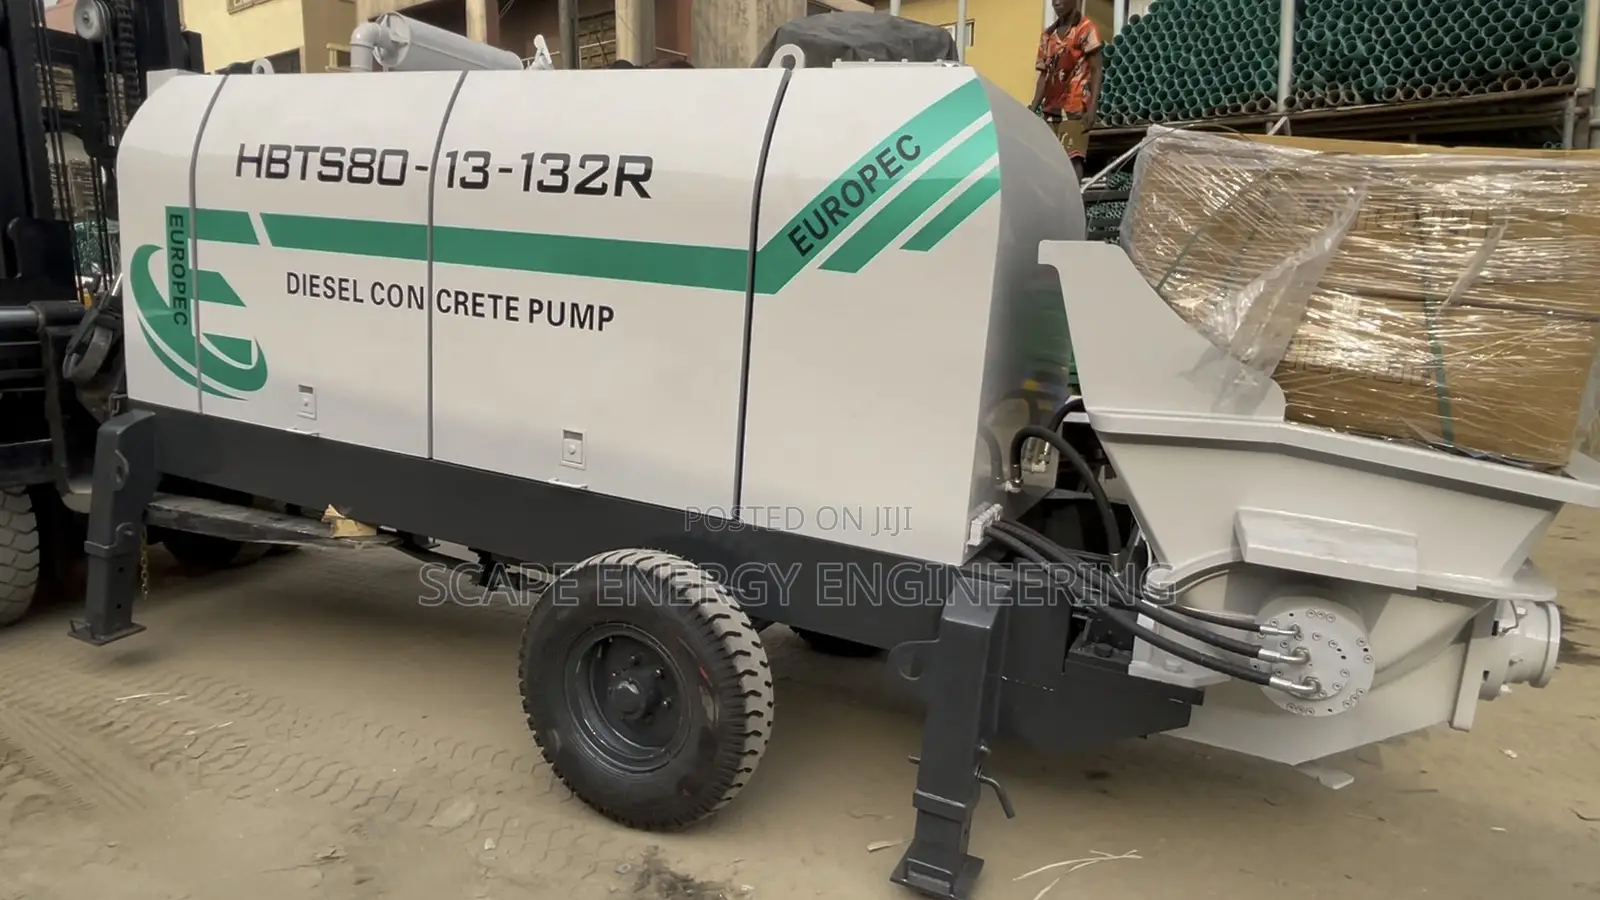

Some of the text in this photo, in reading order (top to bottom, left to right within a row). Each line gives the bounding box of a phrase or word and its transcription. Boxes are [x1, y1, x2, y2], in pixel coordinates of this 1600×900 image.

[786, 133, 922, 257] EUROPEC
[169, 213, 188, 326] EUROPEC
[286, 271, 364, 304] DIESEL
[528, 298, 615, 331] PUMP
